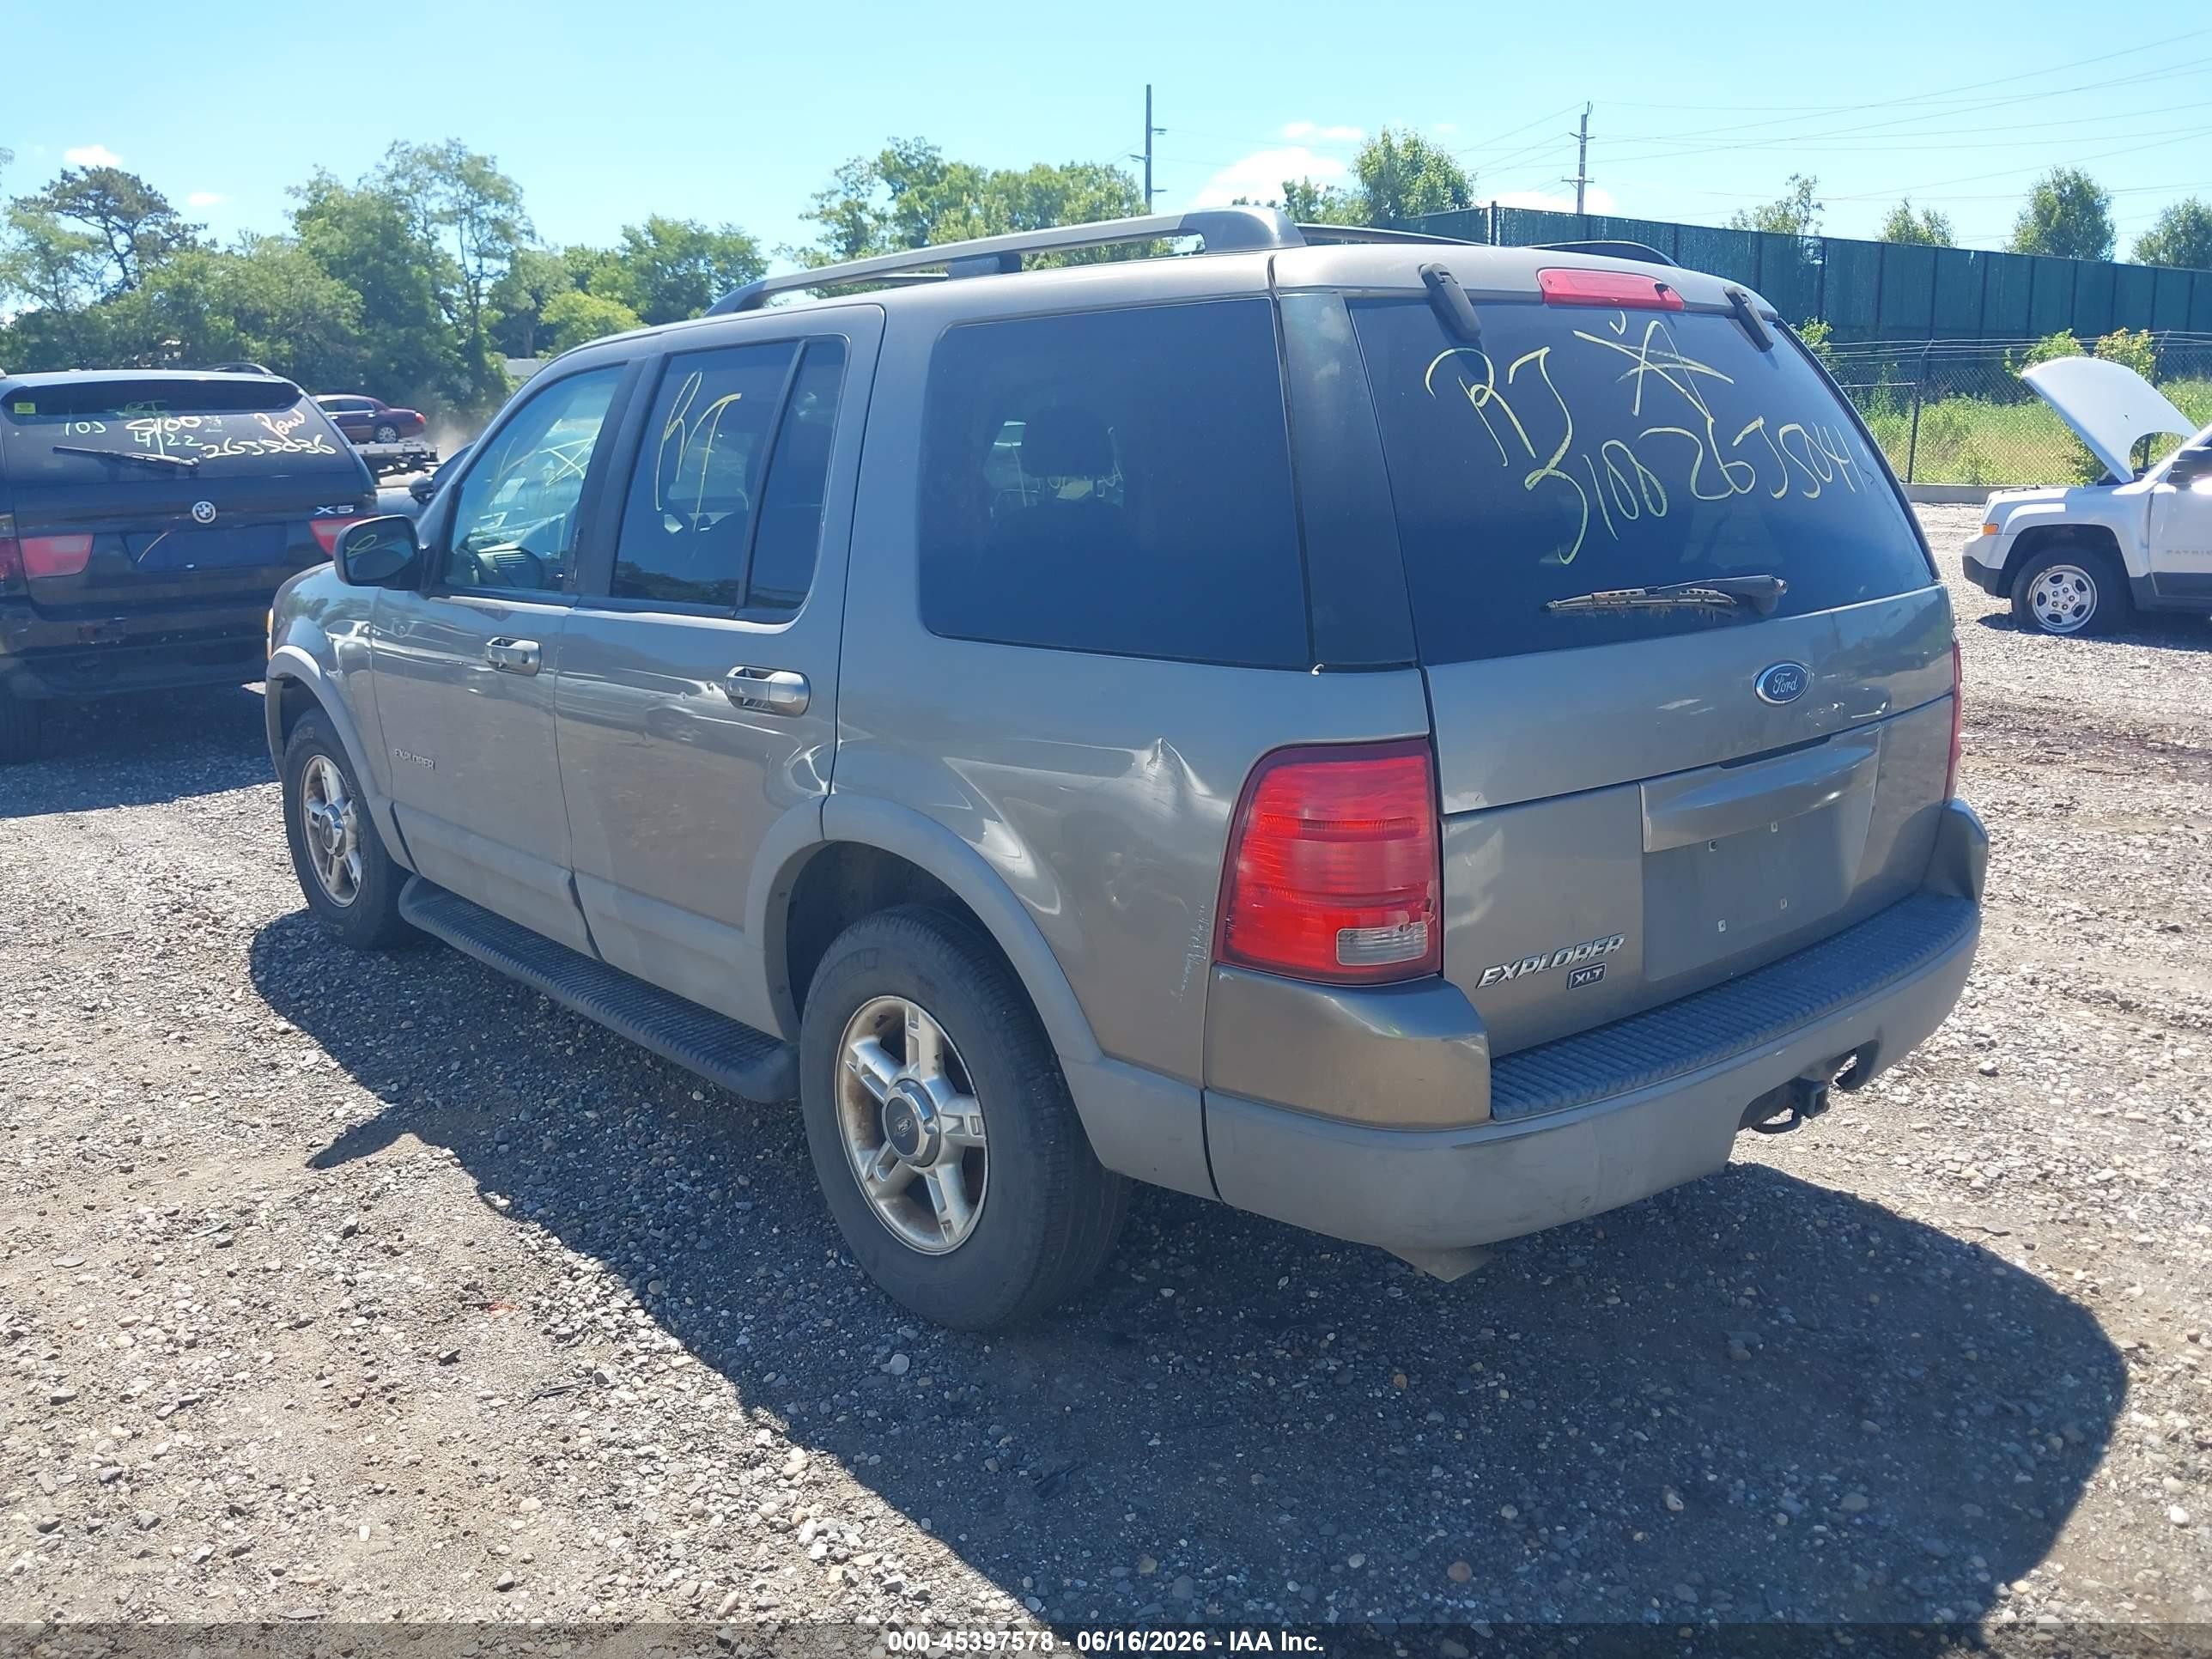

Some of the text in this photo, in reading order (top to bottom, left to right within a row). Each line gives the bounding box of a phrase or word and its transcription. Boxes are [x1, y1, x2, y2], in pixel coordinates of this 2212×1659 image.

[314, 505, 355, 515] X5
[1772, 672, 1800, 695] Ford
[394, 748, 435, 770] EXPLORER
[1476, 933, 1626, 988] EXPLORER
[1571, 965, 1604, 986] XLT
